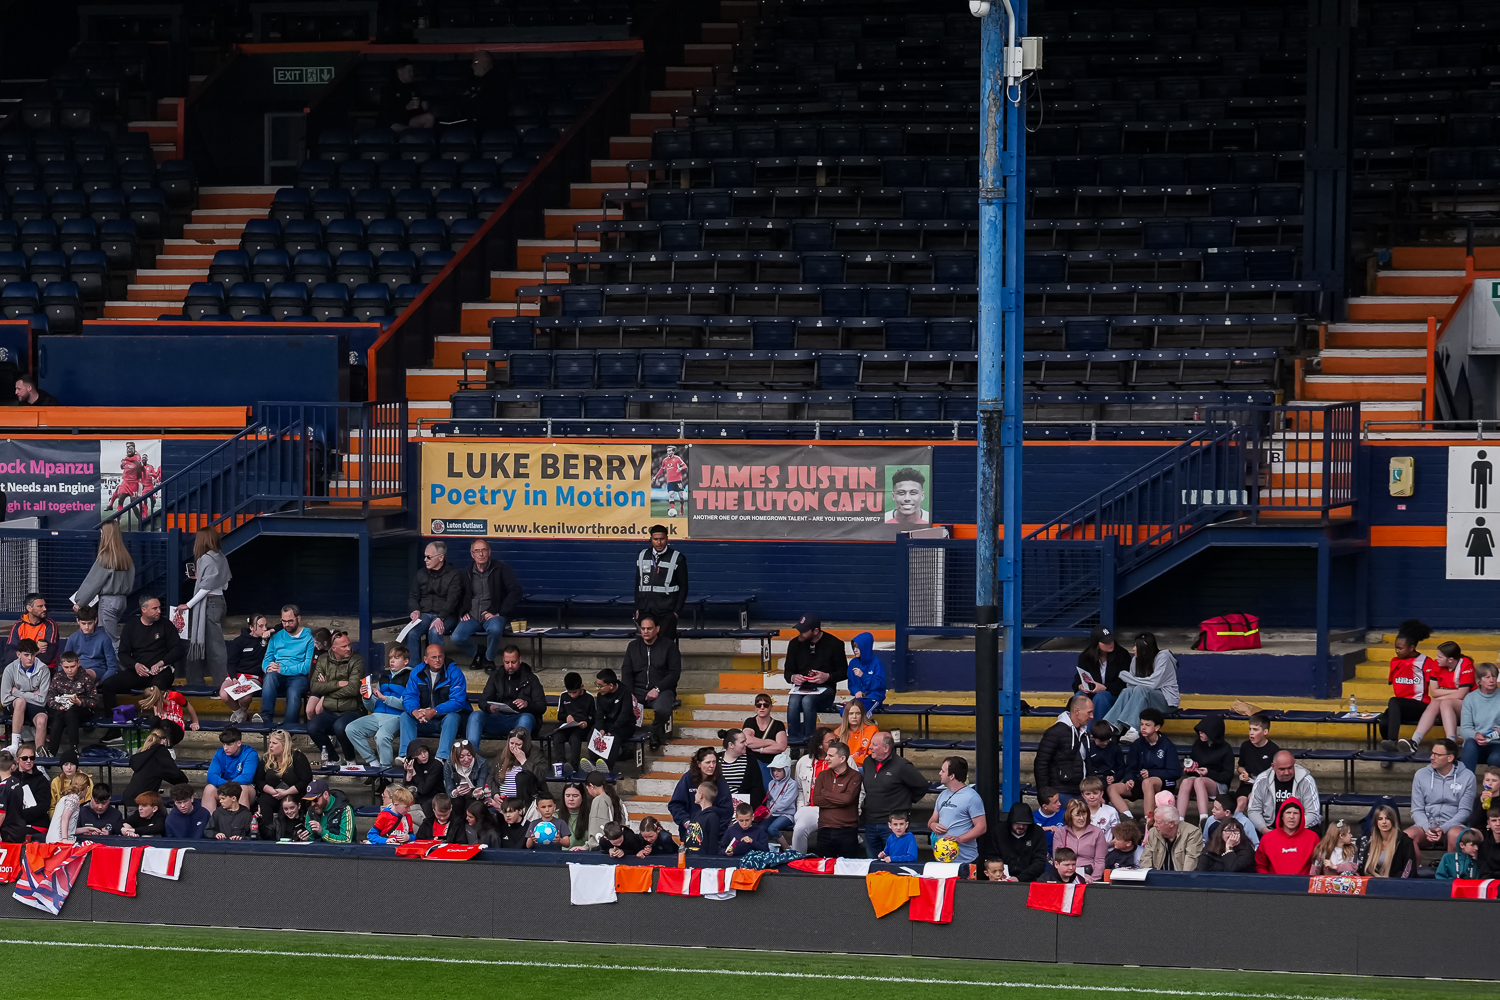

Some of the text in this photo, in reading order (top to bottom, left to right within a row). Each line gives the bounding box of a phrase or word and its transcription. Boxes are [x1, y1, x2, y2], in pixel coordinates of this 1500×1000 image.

[278, 70, 300, 80] EXIT
[1272, 452, 1280, 462] B
[30, 460, 94, 477] Mpanzu
[447, 452, 648, 480] LUKE BERRY
[699, 465, 876, 489] JAMES JUSTIN
[7, 483, 41, 492] Needs
[43, 485, 56, 493] an
[59, 483, 94, 495] Engine
[430, 483, 646, 511] Poetry in Motion
[693, 491, 883, 512] THE LUTON CAFU
[23, 501, 31, 510] it
[33, 501, 46, 511] all
[48, 501, 95, 512] together
[494, 522, 677, 535] www.kenilworthroad.ck
